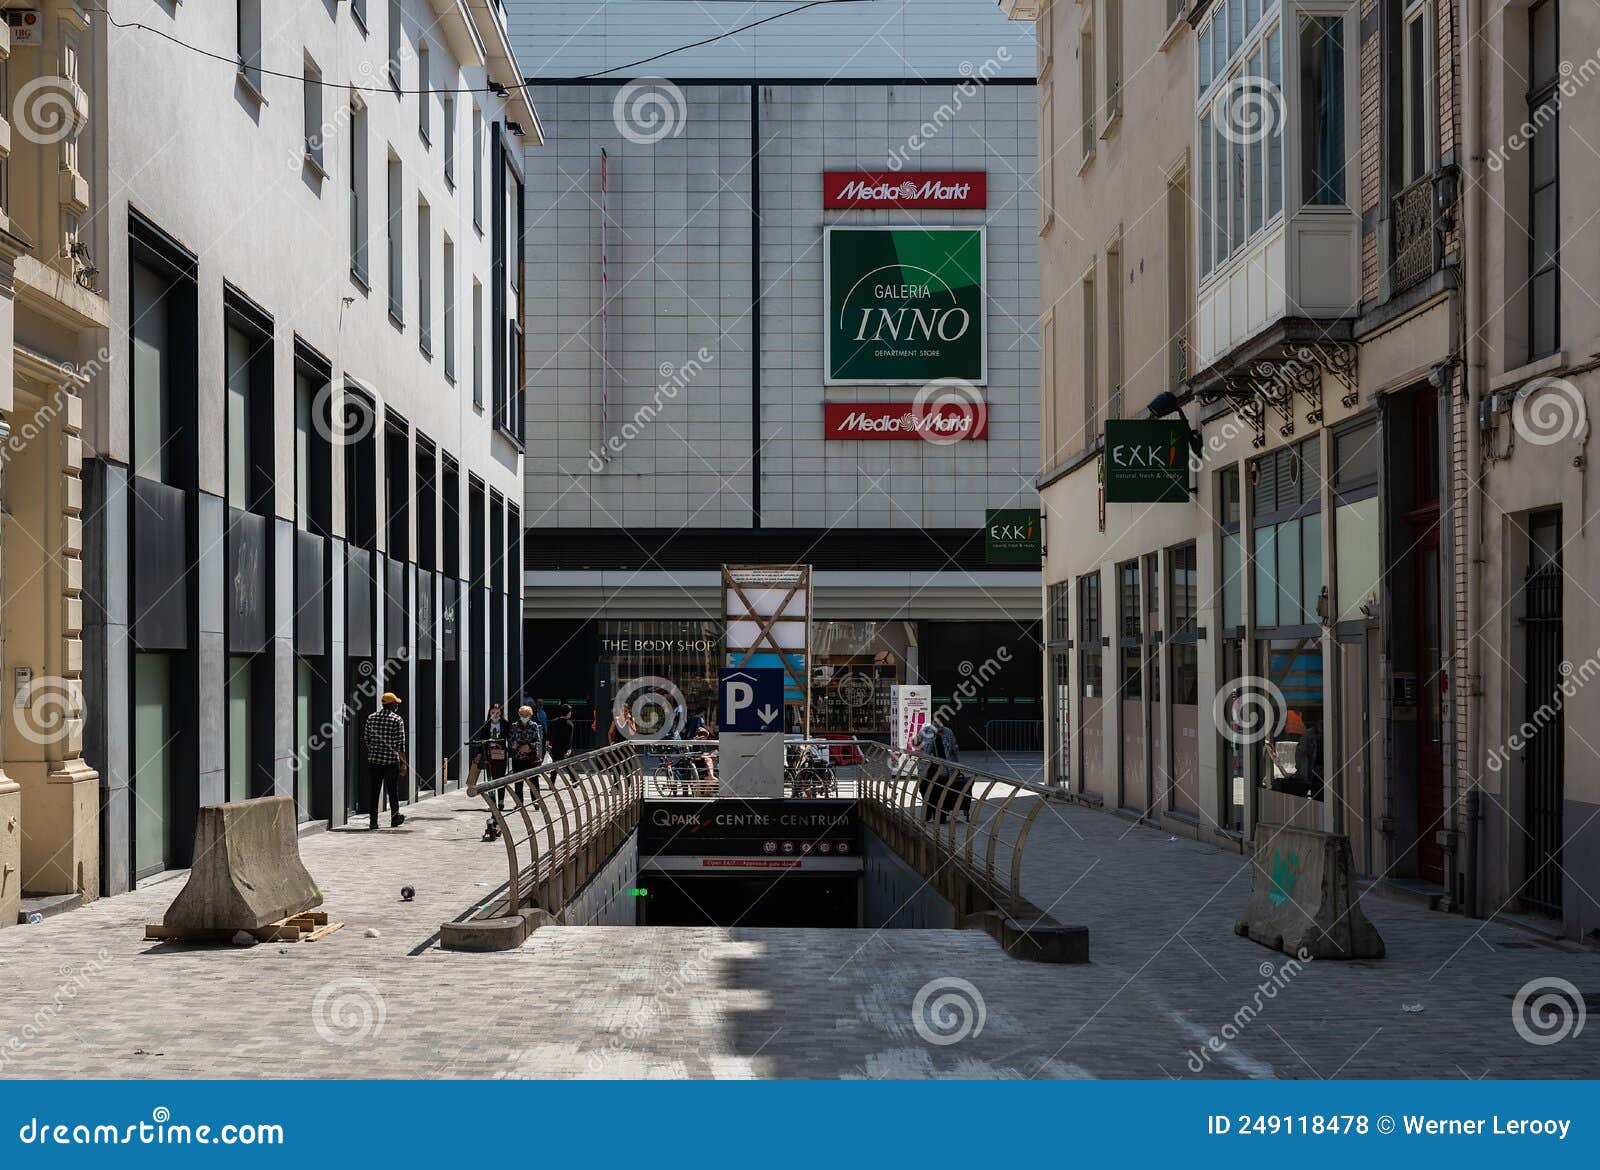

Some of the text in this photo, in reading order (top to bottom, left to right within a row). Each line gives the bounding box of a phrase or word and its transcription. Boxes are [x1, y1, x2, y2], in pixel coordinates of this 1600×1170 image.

[836, 181, 971, 200] Media Markt
[874, 284, 931, 299] GALERIA
[852, 307, 970, 342] INNO
[837, 412, 900, 431] Media
[602, 640, 715, 651] THE BODY SHOP
[726, 681, 754, 725] P
[715, 814, 770, 826] CENTRE
[780, 815, 849, 826] CENTRUM
